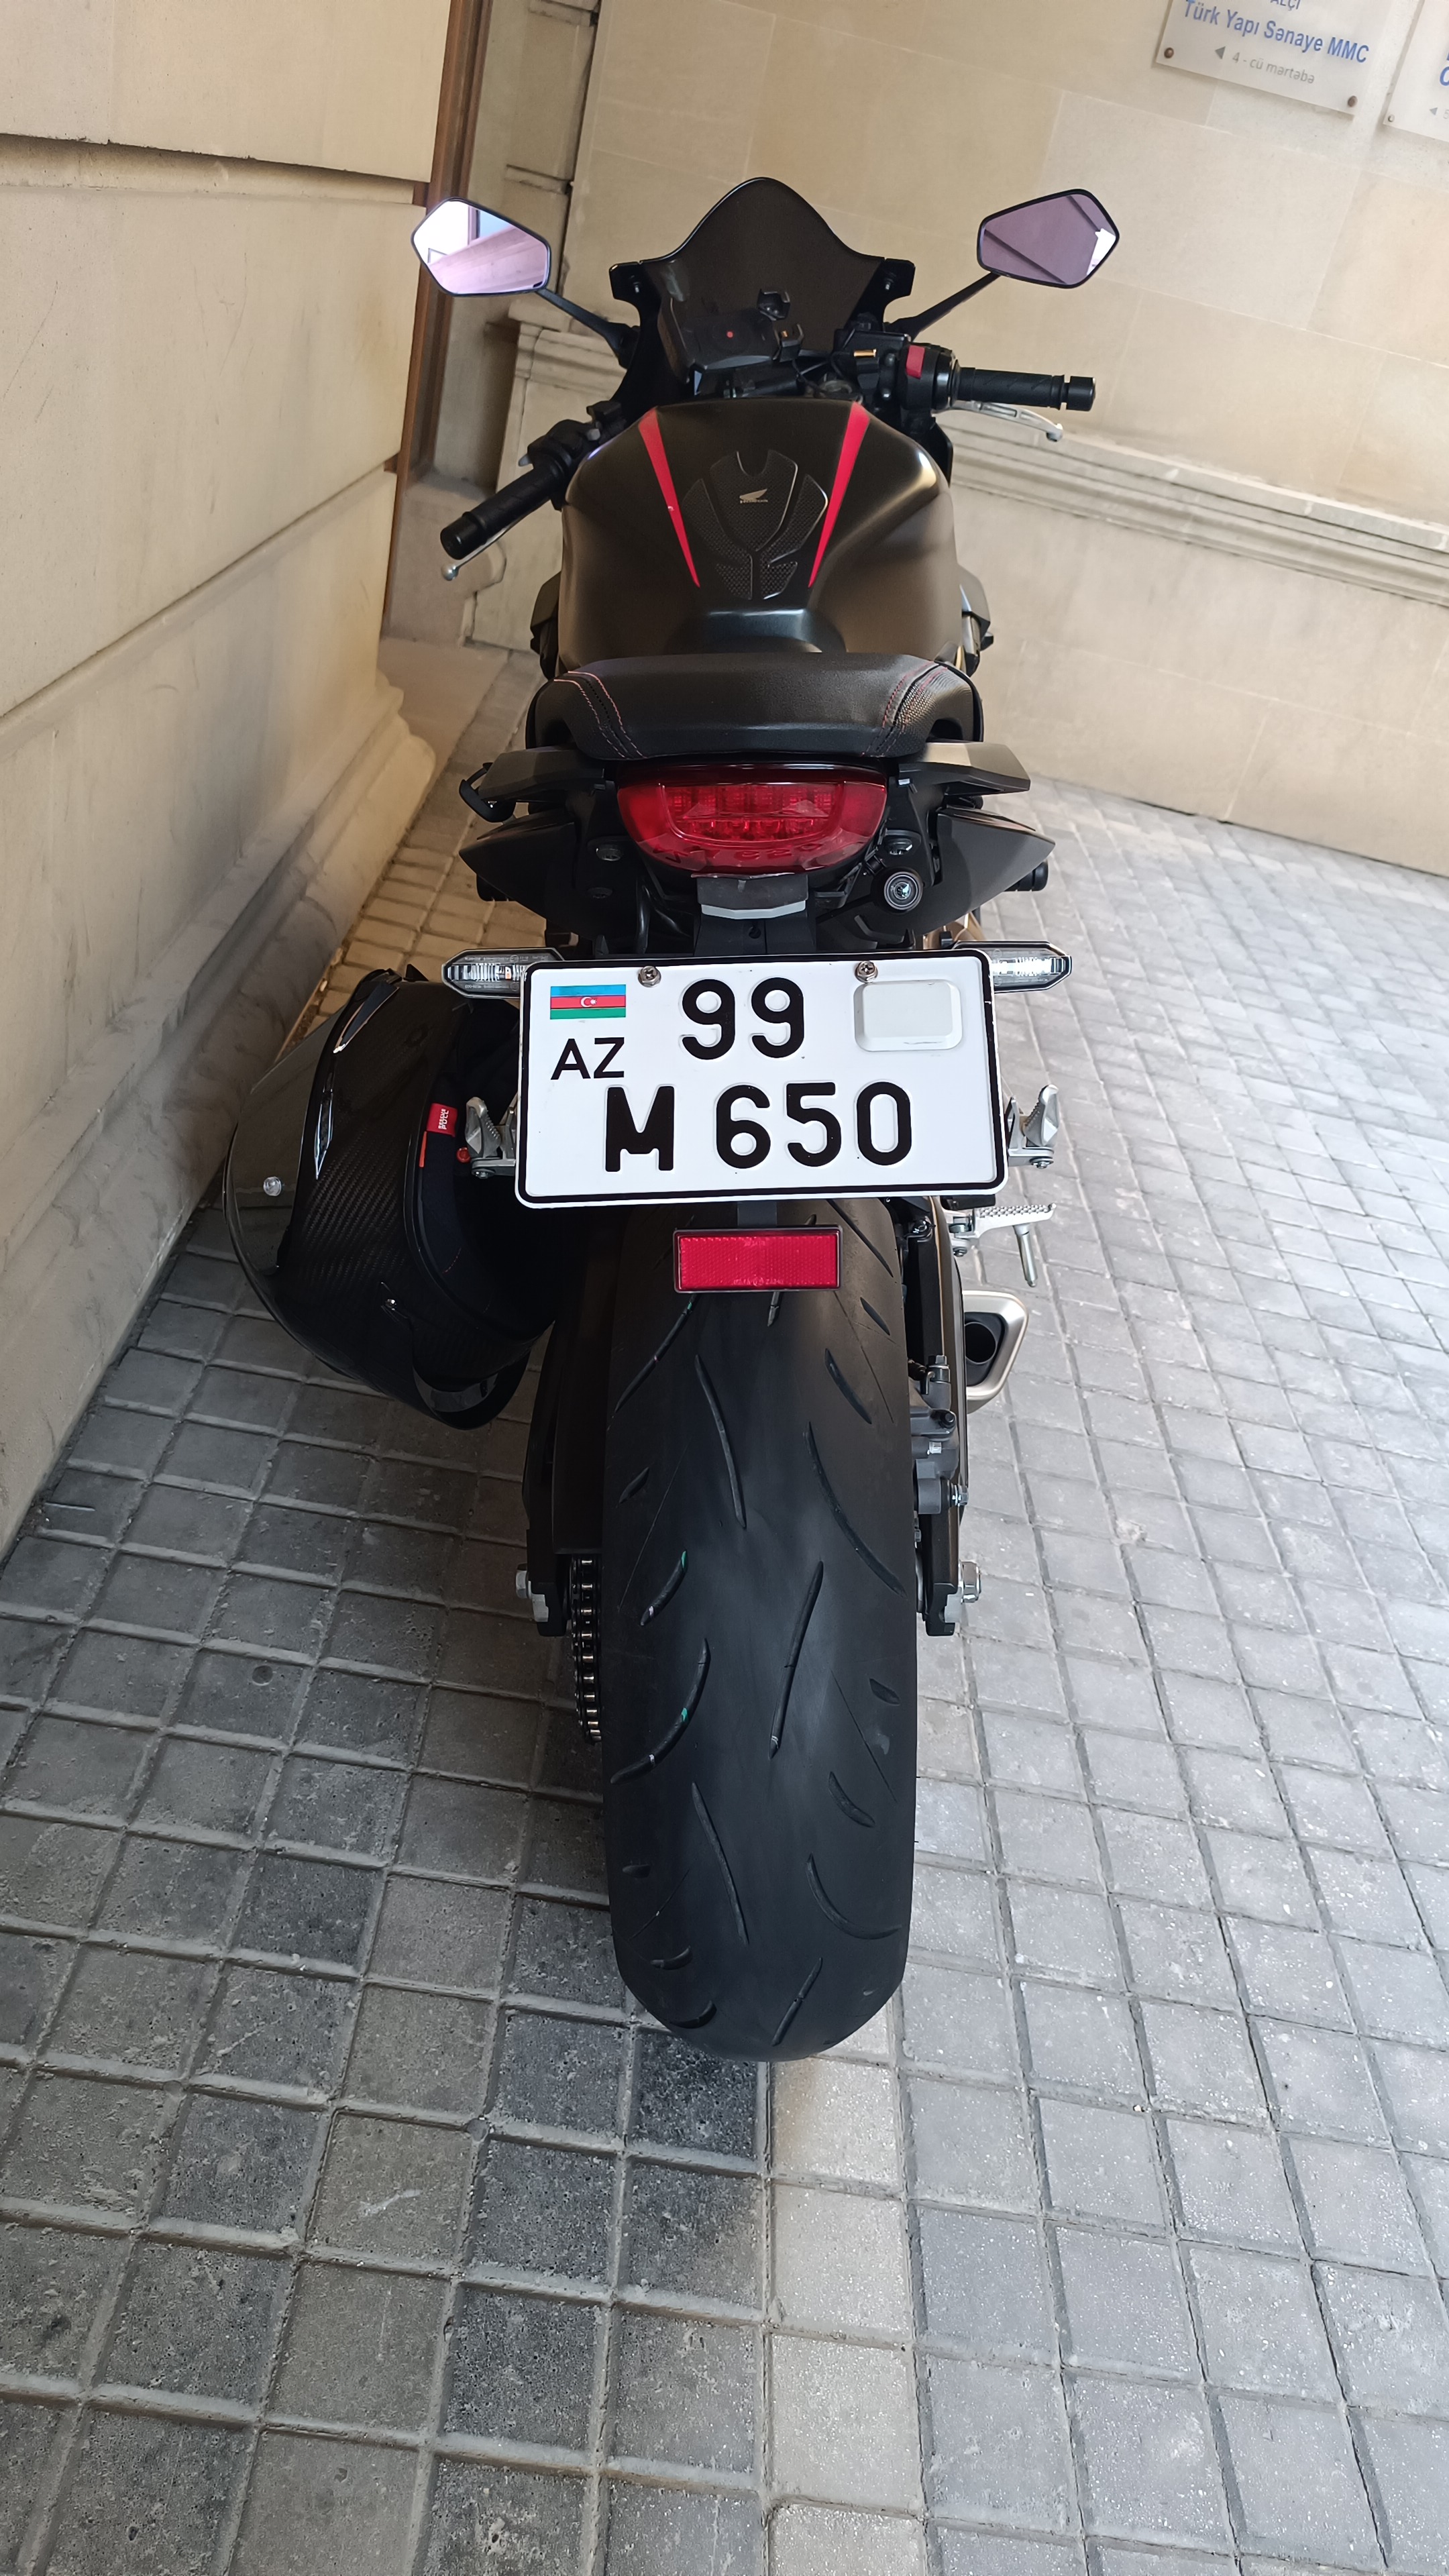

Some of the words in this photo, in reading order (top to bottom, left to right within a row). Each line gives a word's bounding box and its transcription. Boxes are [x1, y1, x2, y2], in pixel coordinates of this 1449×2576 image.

[1185, 0, 1221, 25] Türk
[1226, 9, 1260, 38] Yapı
[1263, 20, 1324, 54] Sənaye
[1326, 36, 1370, 63] MMC
[1265, 62, 1316, 85] mərtəbə
[682, 977, 805, 1060] 99
[550, 1036, 625, 1080] AZ
[605, 1085, 675, 1173] M
[716, 1081, 912, 1169] 650
